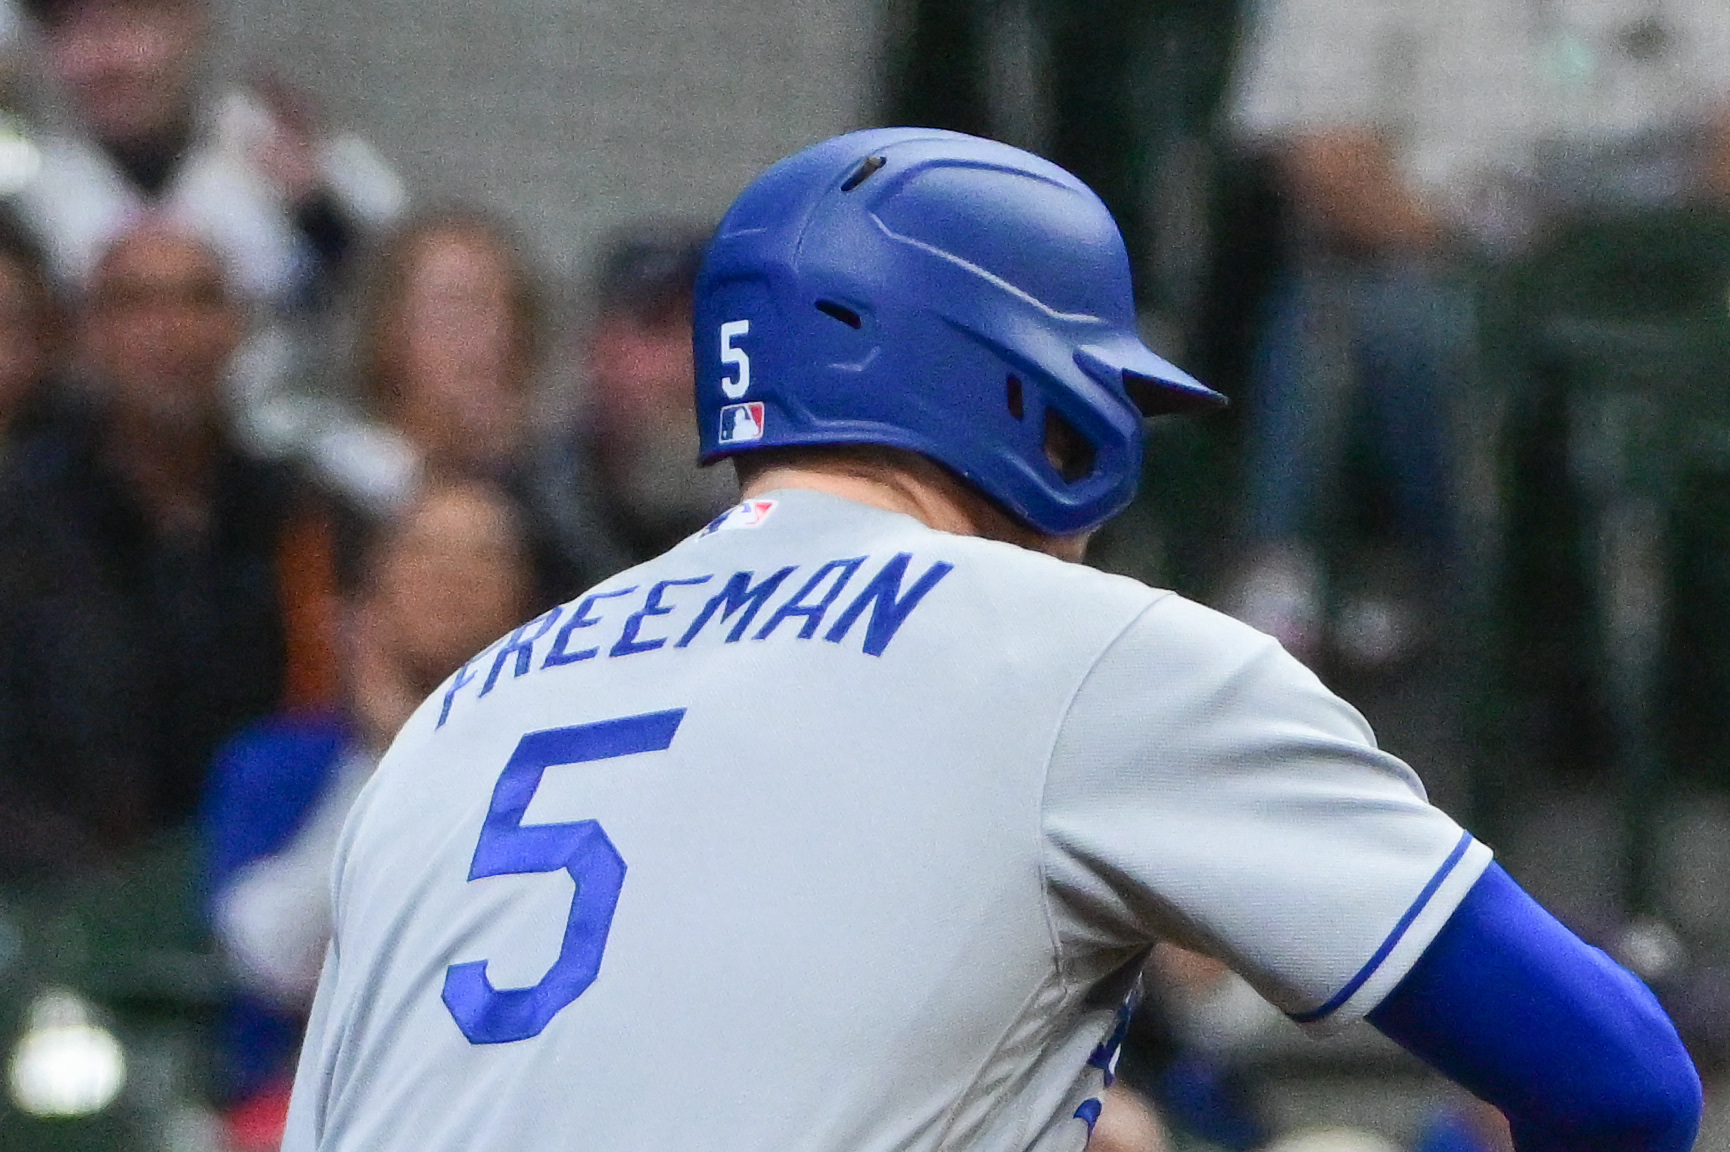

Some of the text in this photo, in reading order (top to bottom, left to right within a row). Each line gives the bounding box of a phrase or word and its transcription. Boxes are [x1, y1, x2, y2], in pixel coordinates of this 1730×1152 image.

[721, 320, 750, 399] 5
[435, 551, 955, 731] FREEMAN
[441, 707, 688, 1045] 5
